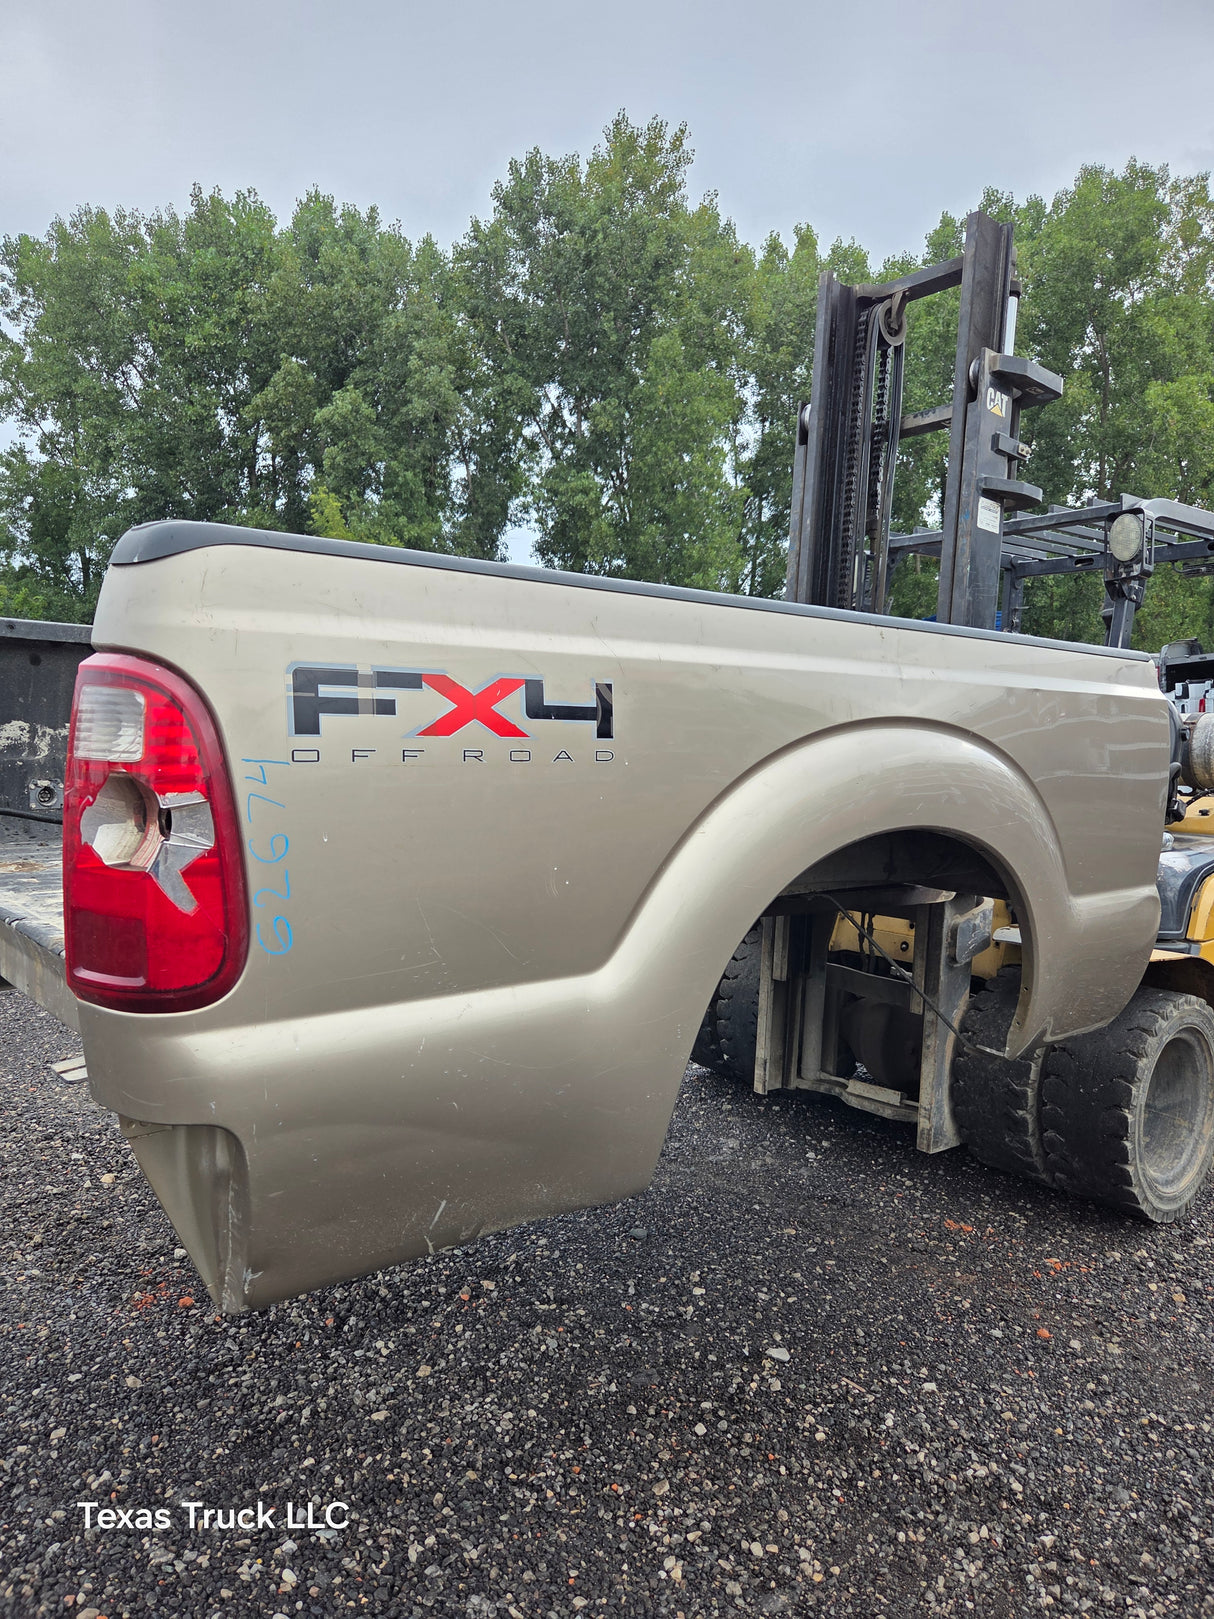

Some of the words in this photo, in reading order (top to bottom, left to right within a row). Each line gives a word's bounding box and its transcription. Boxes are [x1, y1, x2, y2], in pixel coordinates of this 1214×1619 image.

[986, 387, 1009, 418] CAT
[287, 662, 614, 739] FX4
[241, 758, 294, 956] 62674
